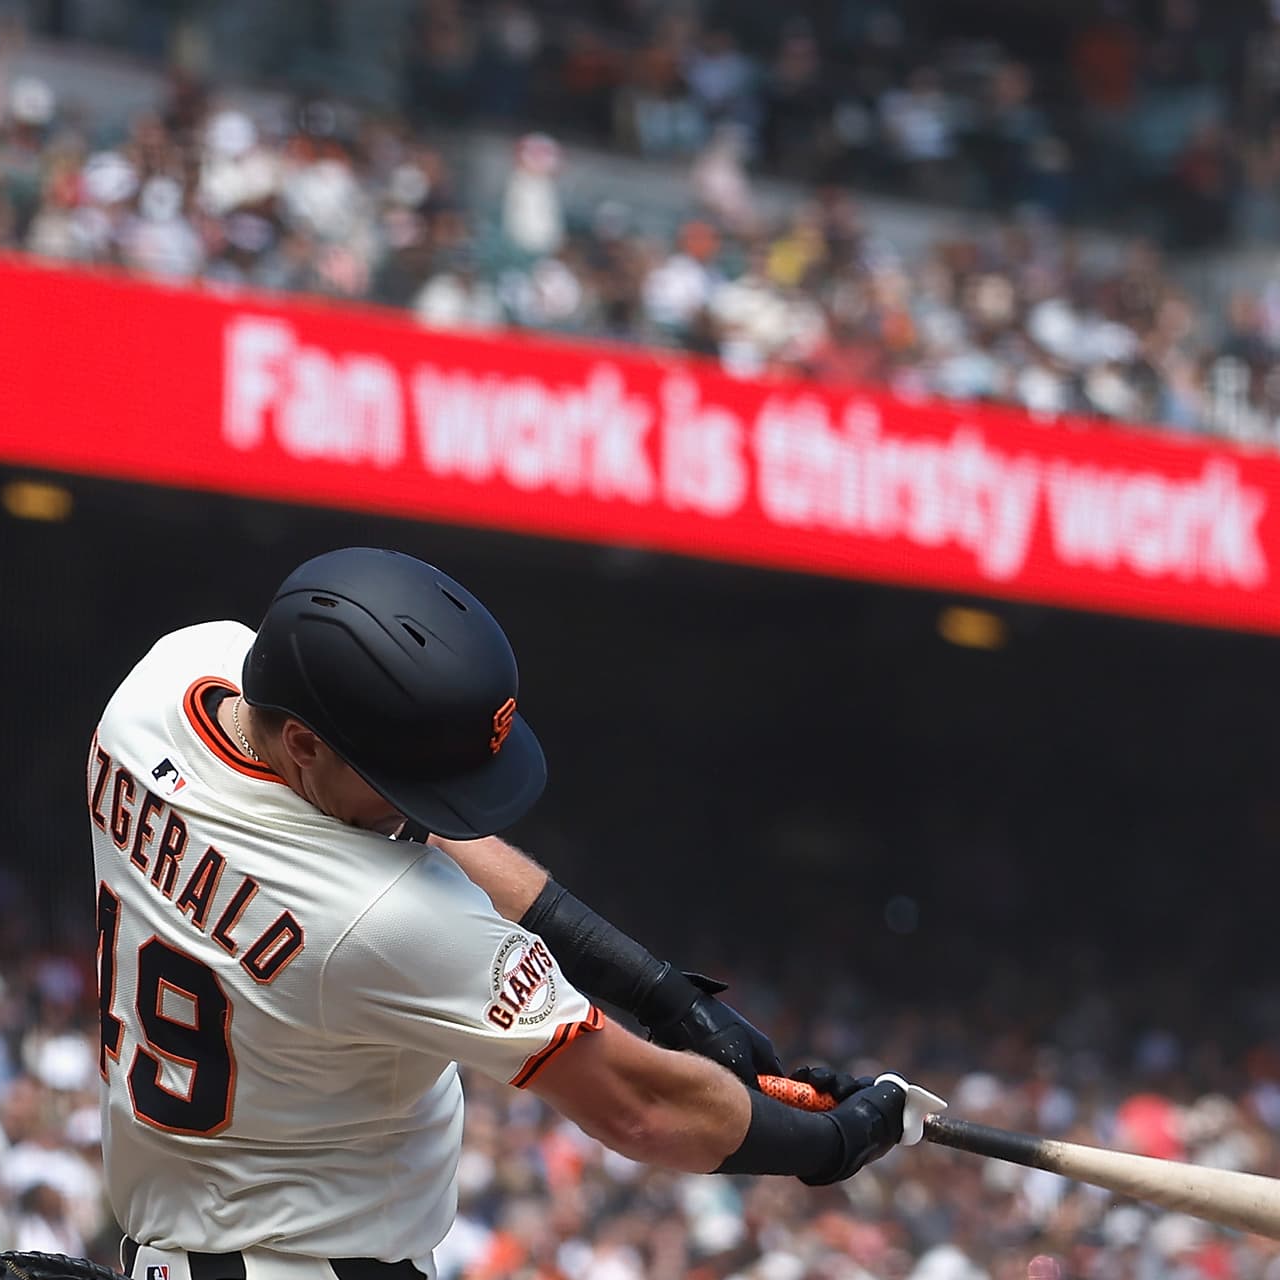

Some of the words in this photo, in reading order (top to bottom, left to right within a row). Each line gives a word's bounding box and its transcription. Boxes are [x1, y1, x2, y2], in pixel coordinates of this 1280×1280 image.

[223, 315, 405, 470] Fan
[412, 362, 655, 503] work
[661, 367, 748, 518] is
[755, 395, 1040, 582] thirsty
[1044, 457, 1269, 589] work
[87, 734, 305, 986] ZGERALD
[488, 940, 554, 1031] GIANTS
[493, 966, 502, 992] SAN
[518, 1004, 555, 1026] BASEBALL
